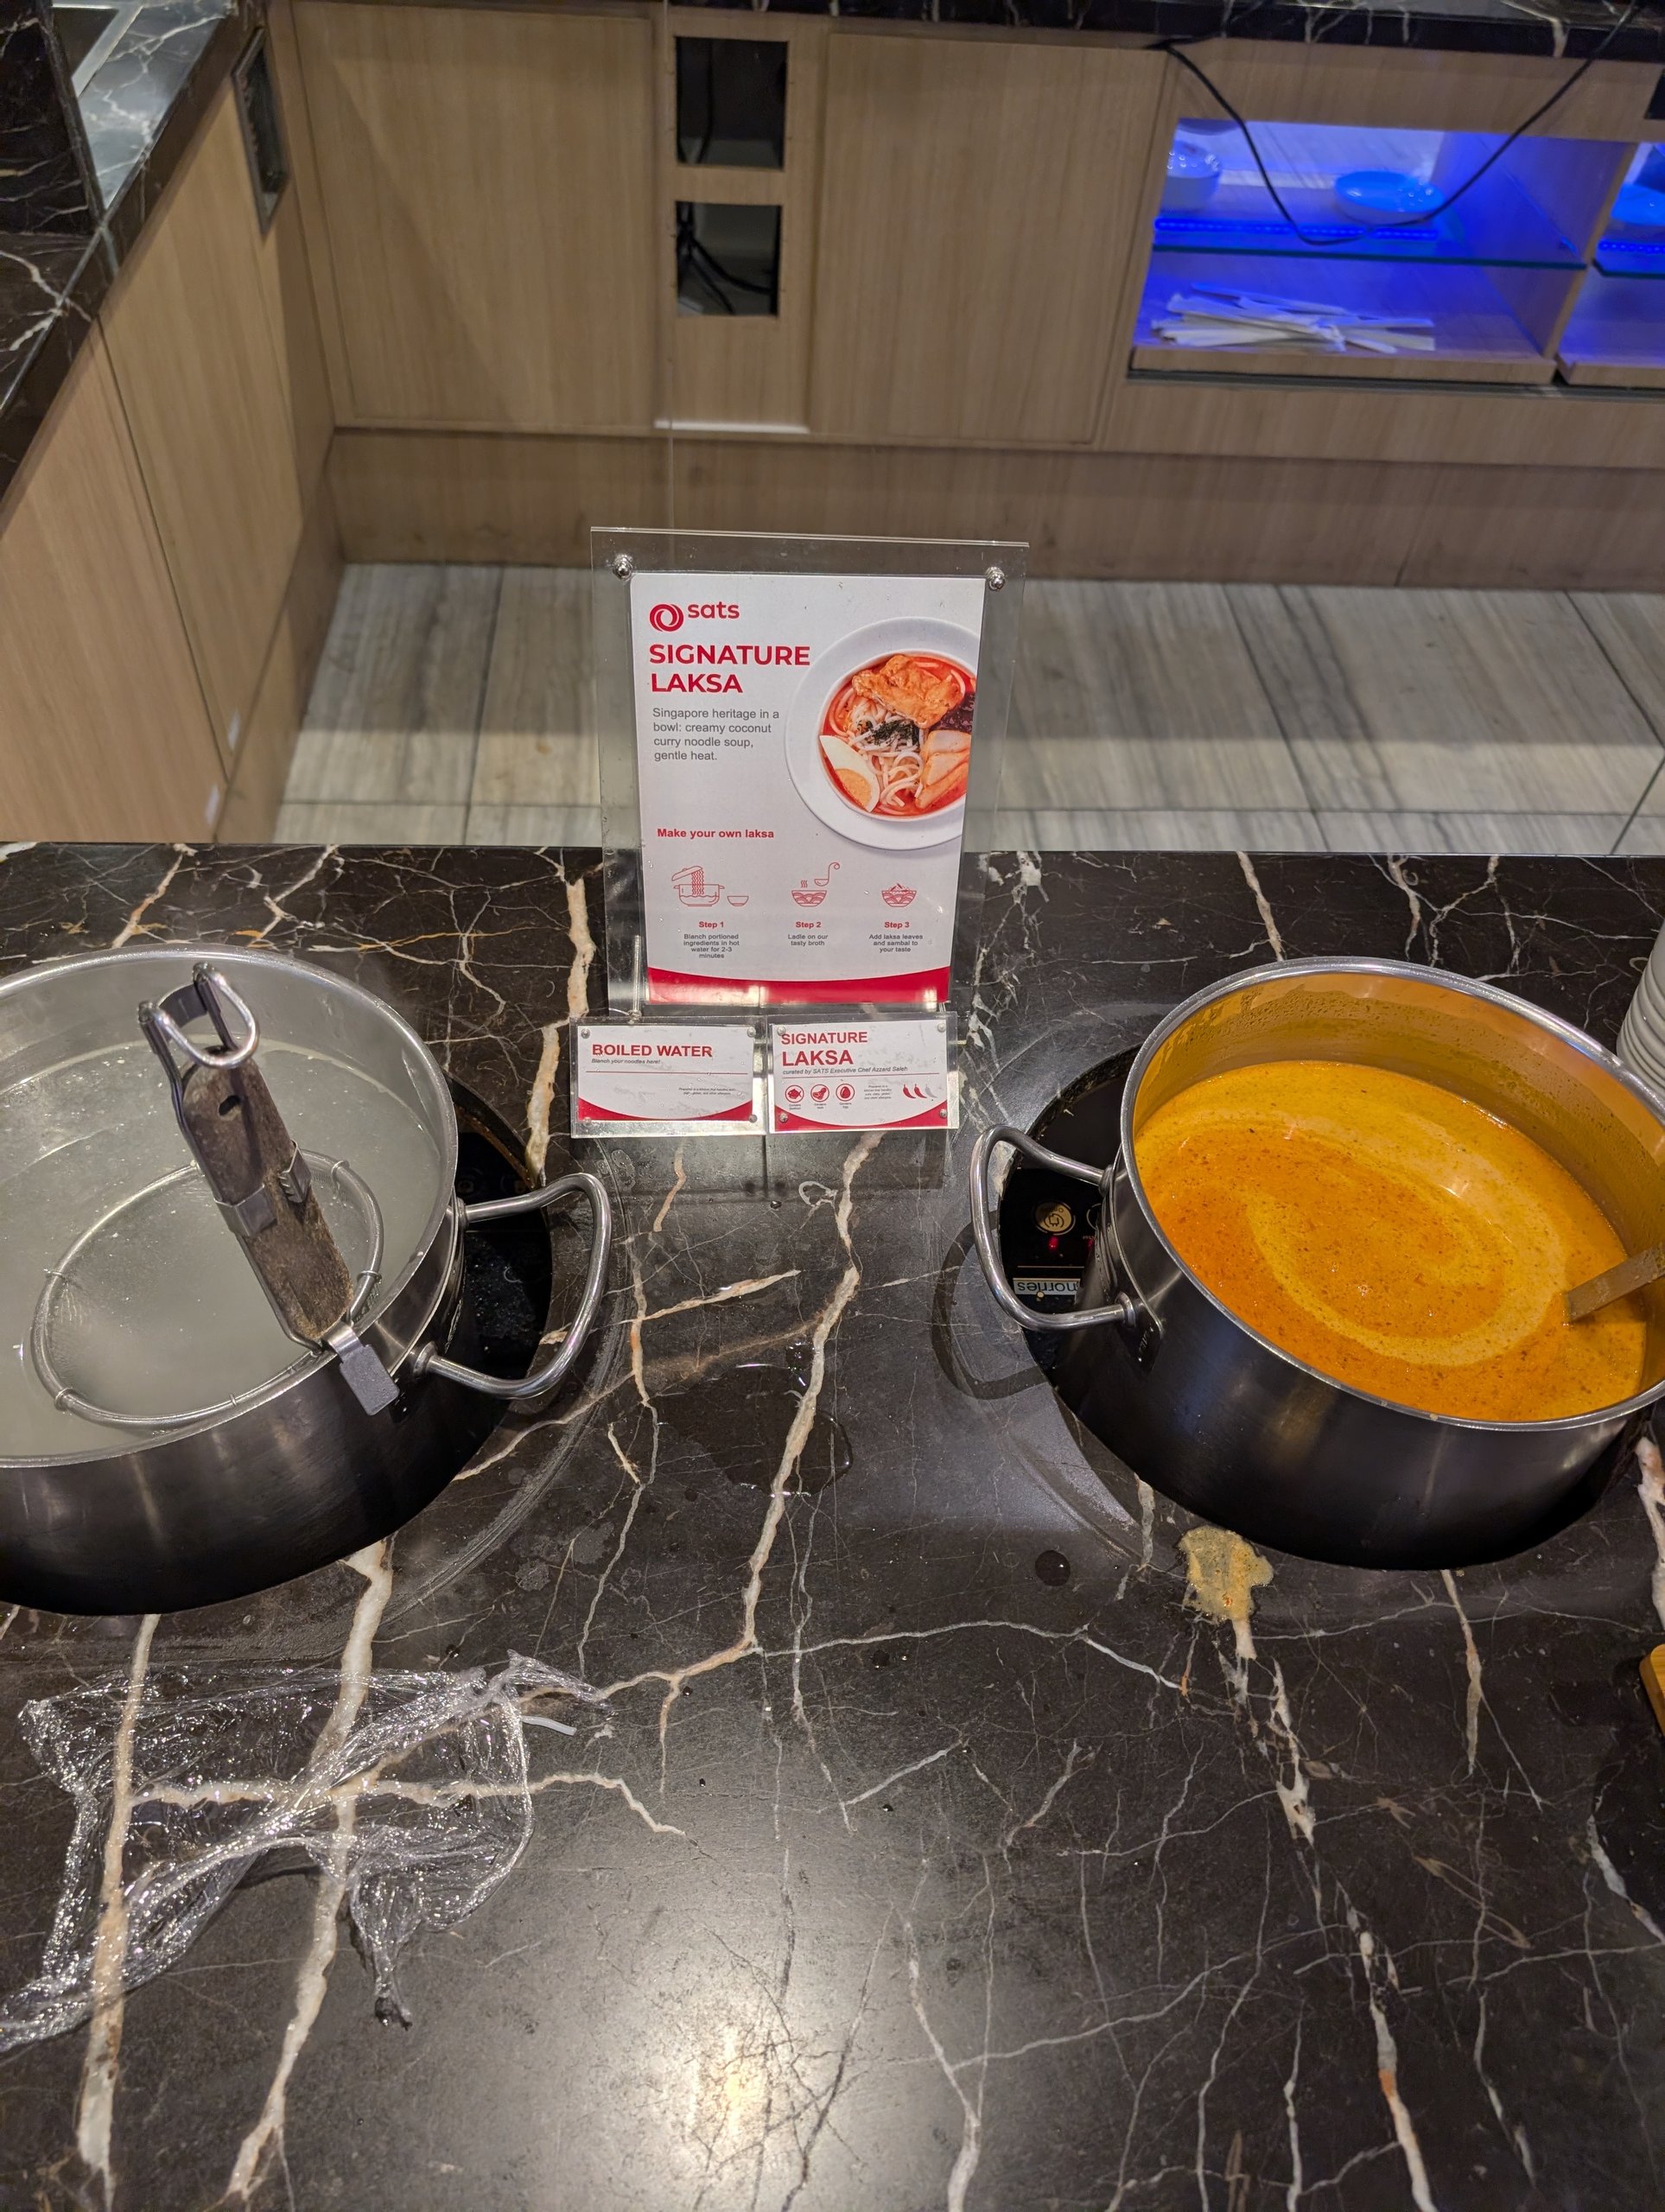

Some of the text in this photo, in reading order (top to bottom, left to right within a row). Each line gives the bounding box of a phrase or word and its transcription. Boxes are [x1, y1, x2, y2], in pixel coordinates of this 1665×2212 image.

[688, 601, 740, 620] sats
[649, 644, 810, 666] SIGNATURE
[651, 673, 743, 693] LAKSA
[652, 707, 709, 720] Singapore
[712, 709, 756, 720] heritage
[760, 709, 769, 719] in
[653, 722, 772, 734] bowl: creamy coconut
[654, 737, 753, 749] curry noodle soup,
[654, 750, 717, 761] gentle heat.
[658, 829, 687, 838] Make
[690, 830, 716, 840] your
[745, 829, 774, 838] laksa
[781, 1032, 867, 1045] SIGNATURE
[592, 1045, 713, 1057] BOILED WATER
[783, 1050, 854, 1066] LAKSA
